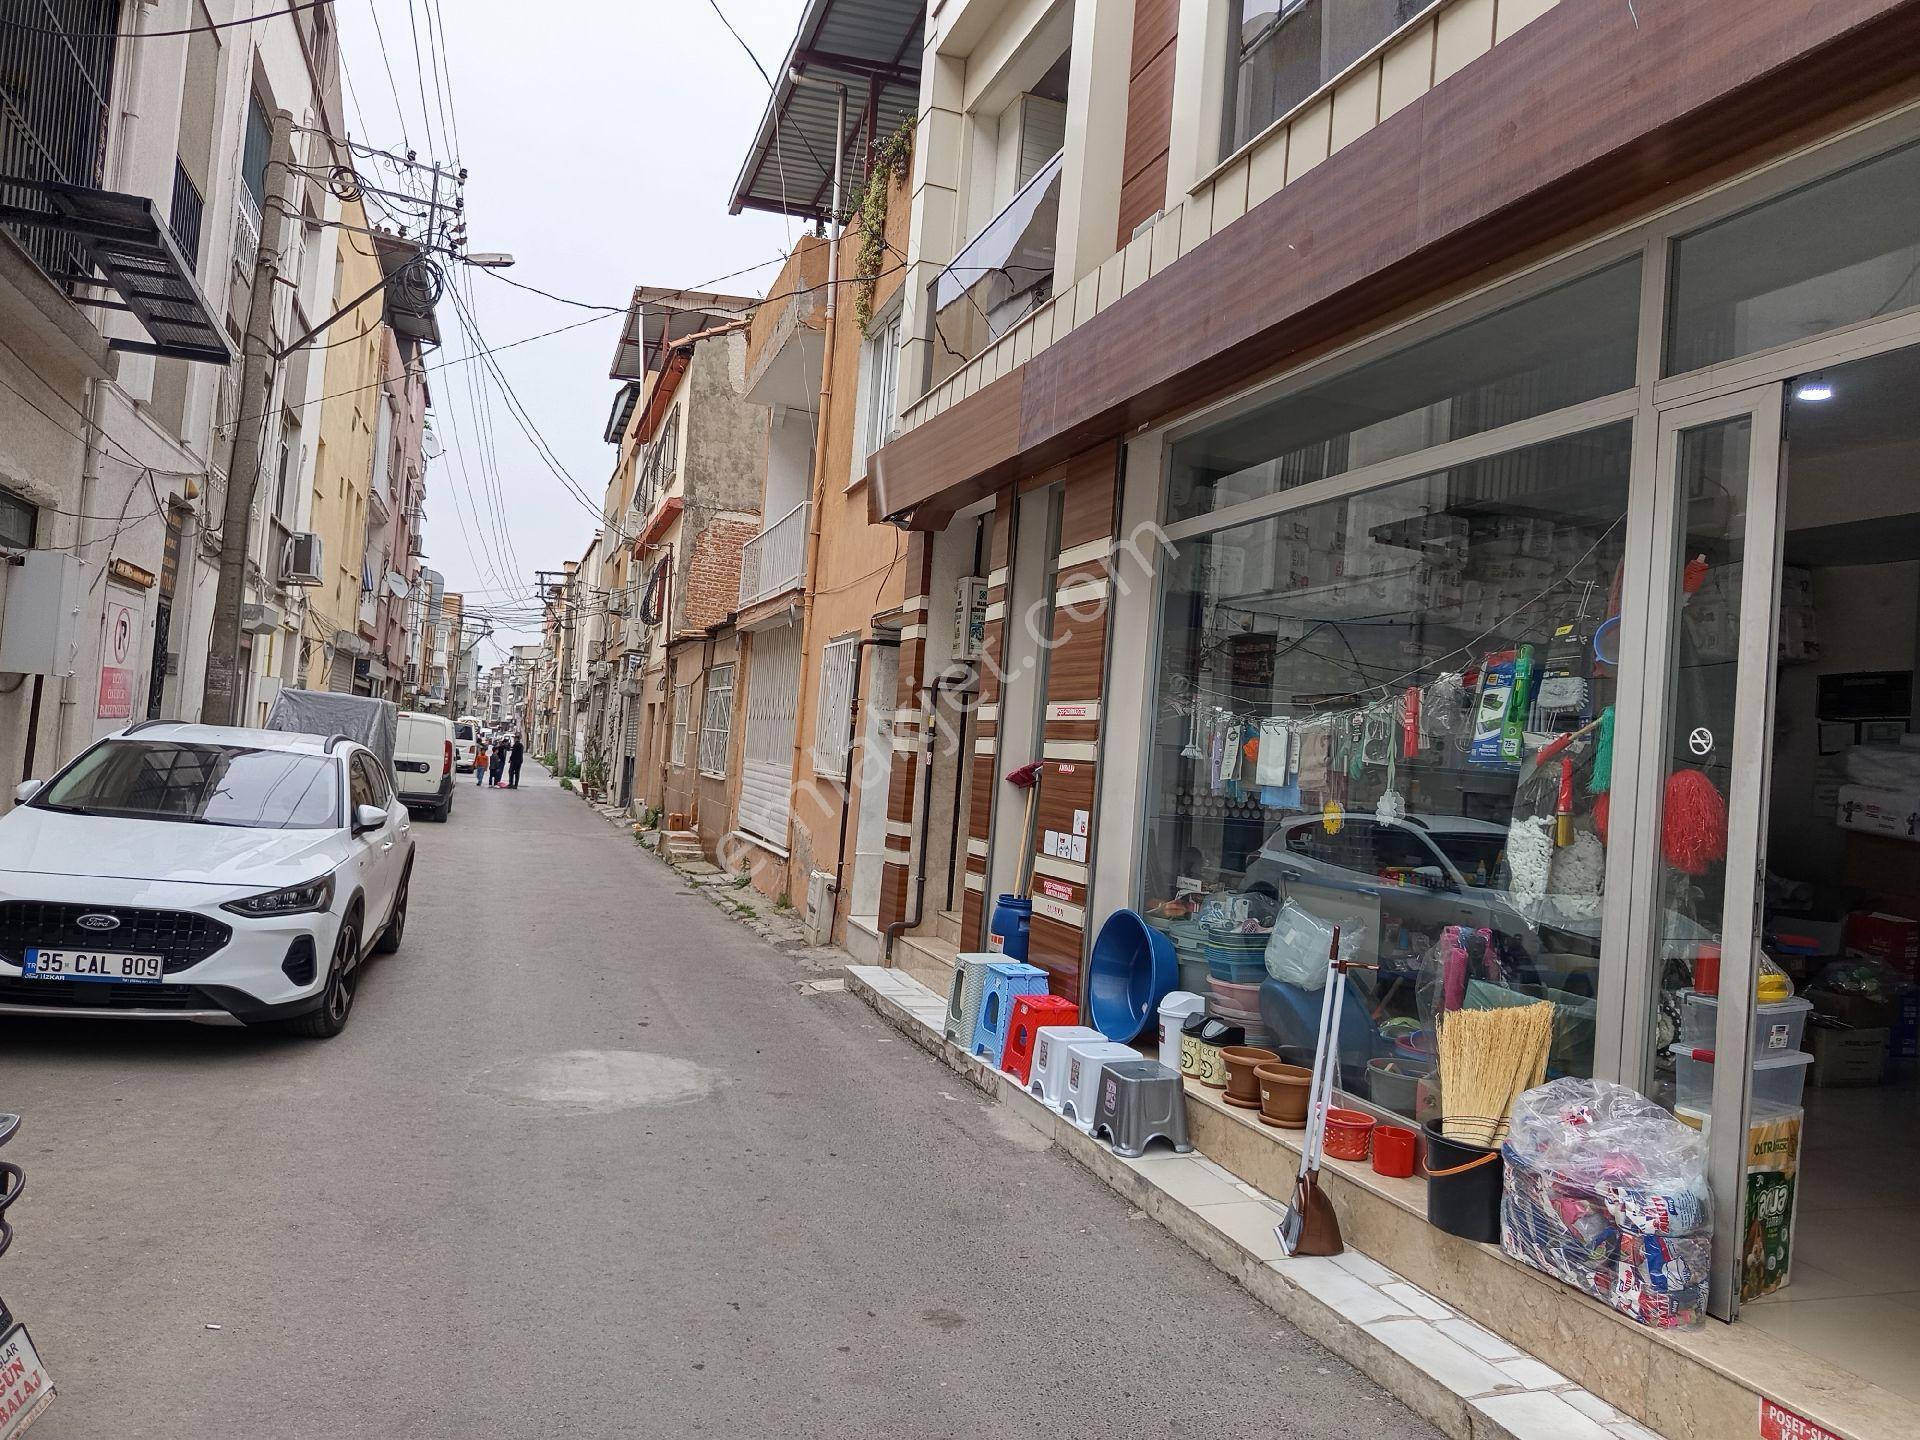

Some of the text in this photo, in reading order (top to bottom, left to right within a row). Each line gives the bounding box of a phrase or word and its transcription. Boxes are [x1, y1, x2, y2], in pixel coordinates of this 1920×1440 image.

[86, 917, 110, 927] Ford
[38, 952, 159, 976] 35 CAL 809
[0, 1369, 42, 1430] BALAJ
